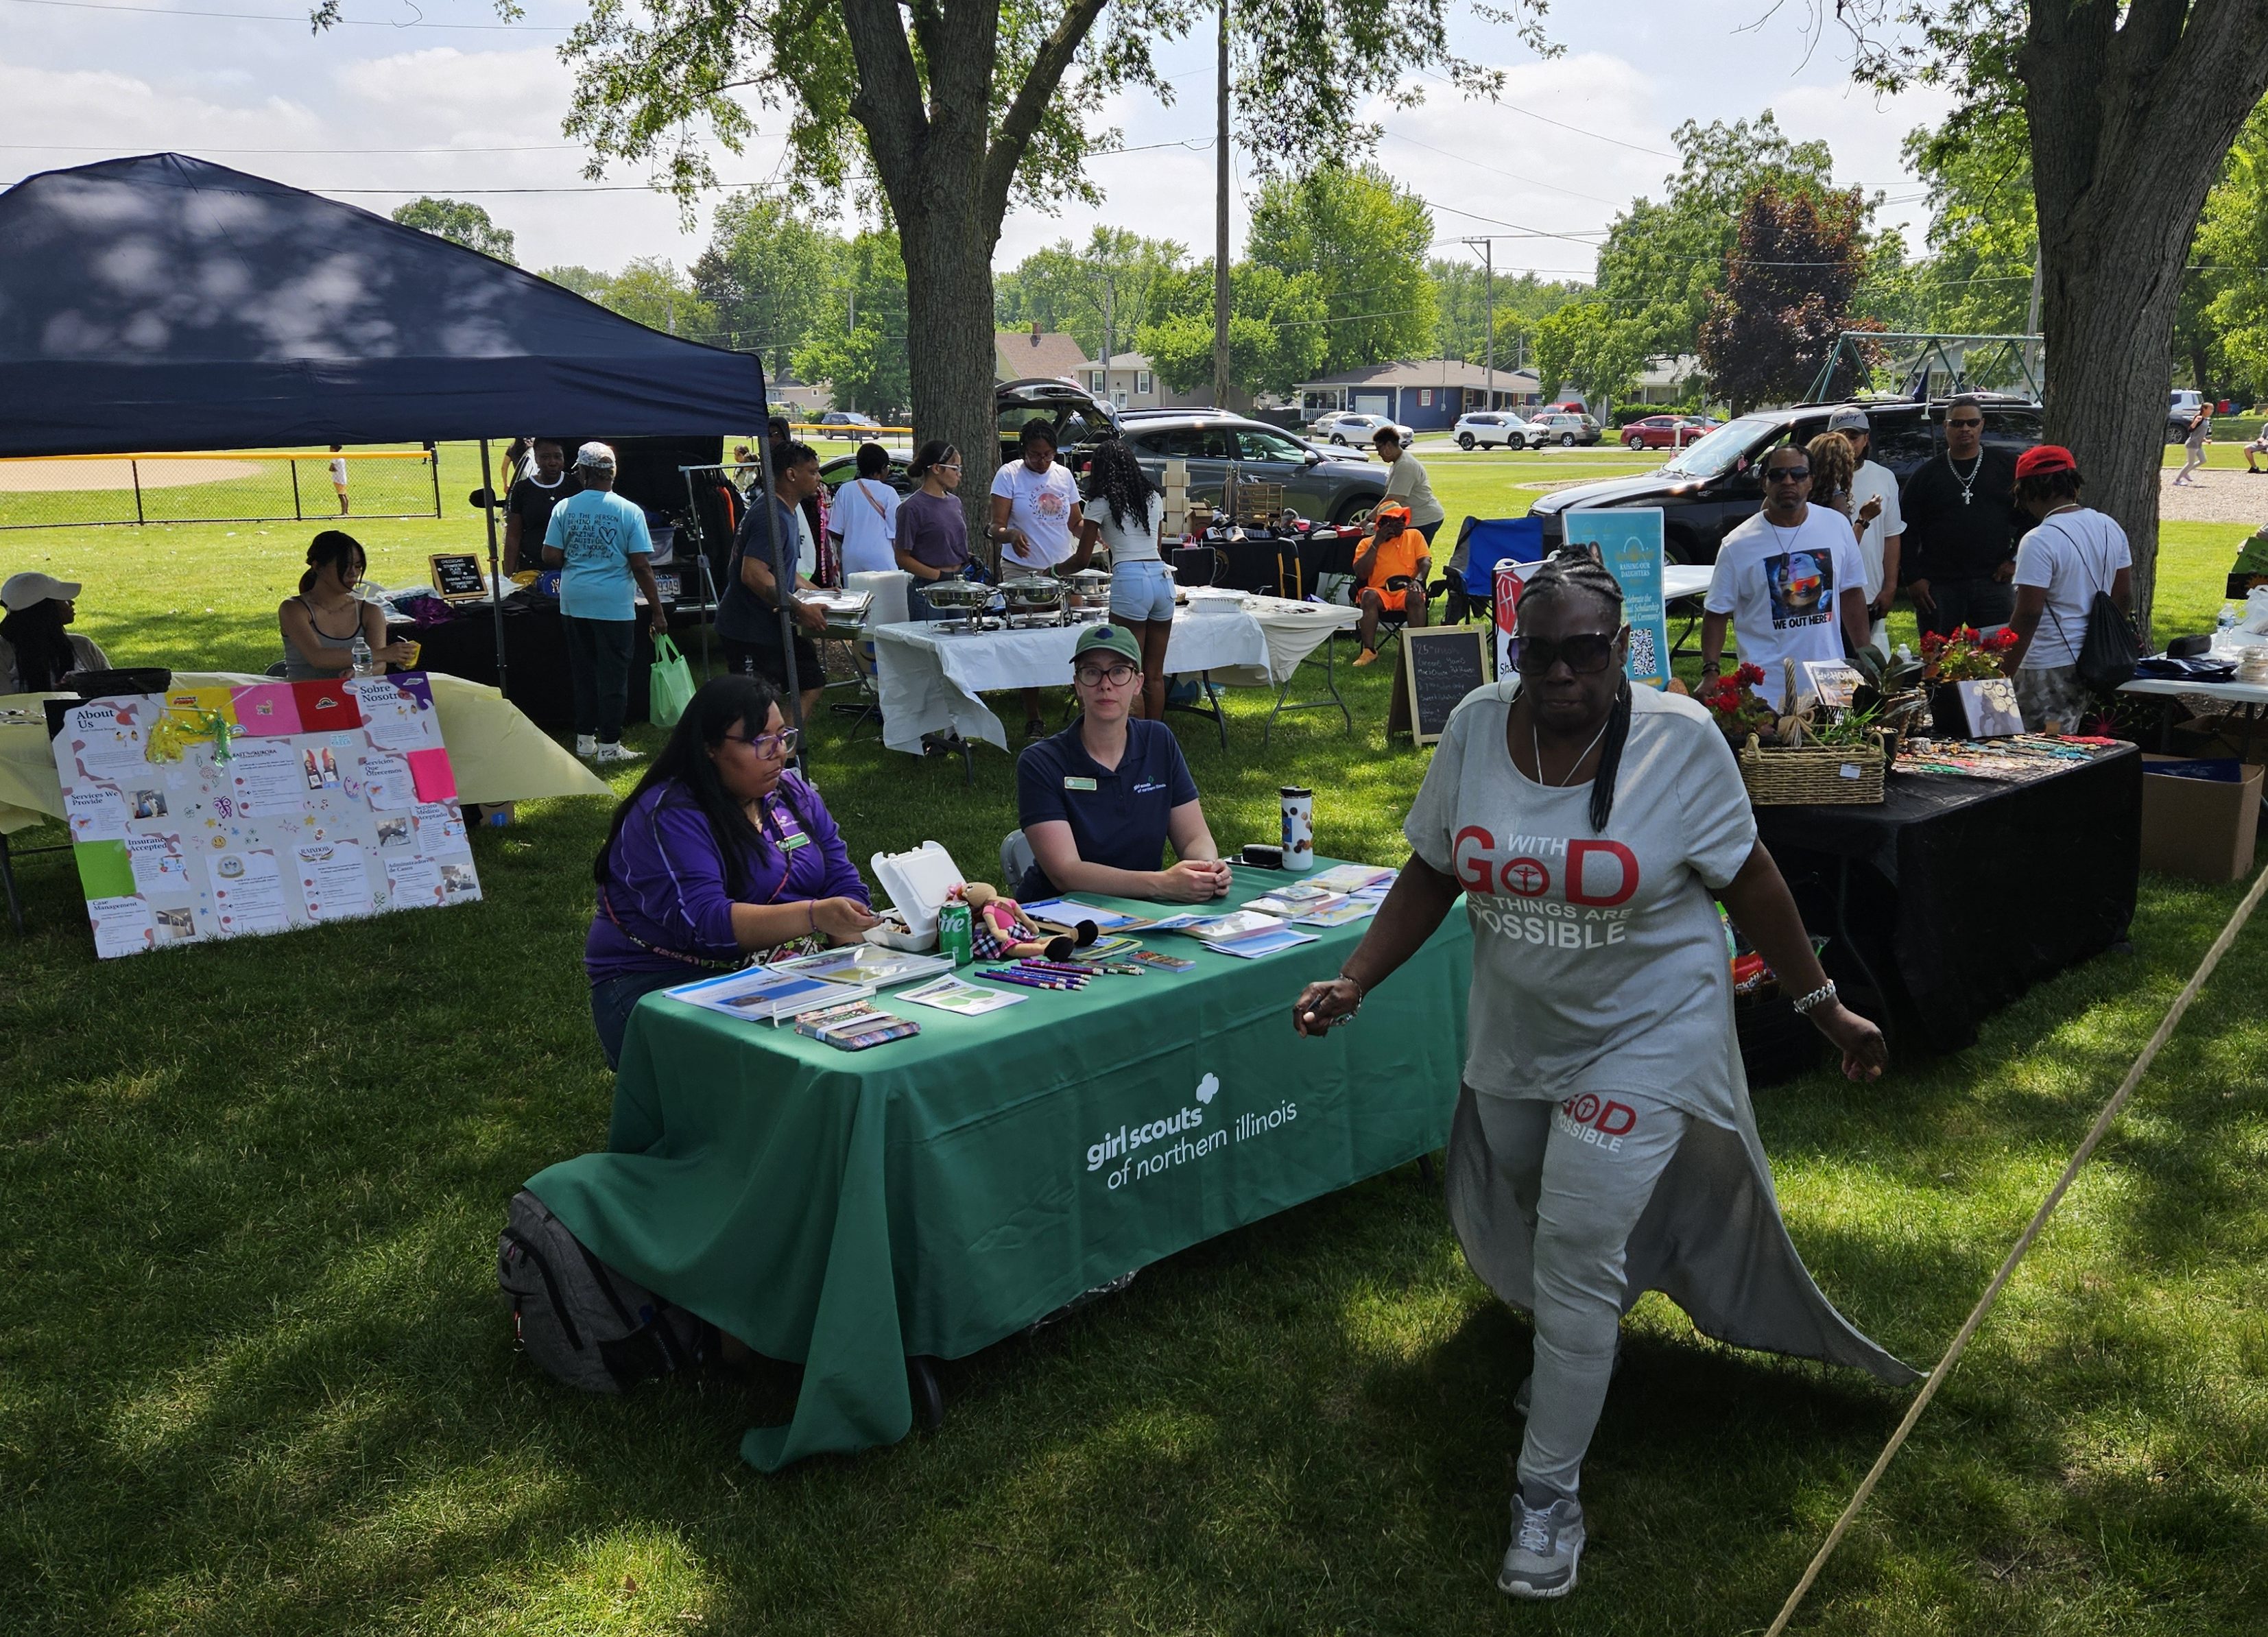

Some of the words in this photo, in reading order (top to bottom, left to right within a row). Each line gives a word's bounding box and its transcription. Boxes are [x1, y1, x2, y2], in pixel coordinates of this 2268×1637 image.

[595, 514, 618, 522] PERSON
[1773, 619, 1787, 630] WE
[1789, 617, 1807, 628] OUT
[360, 684, 390, 694] Sobre
[77, 709, 115, 719] About
[78, 720, 94, 728] Us
[364, 758, 394, 766] Servicios
[418, 813, 448, 821] Aceptado
[128, 837, 168, 846] Insurance
[1509, 833, 1568, 857] WITH
[130, 844, 167, 852] Accepted
[94, 902, 137, 911] Management
[1492, 896, 1577, 920] THINGS
[1584, 907, 1634, 921] ARE
[940, 913, 965, 933] ite
[1468, 903, 1627, 950] POSSIBLE
[1087, 1124, 1127, 1171] girl
[1130, 1106, 1203, 1149] scouts
[1107, 1157, 1132, 1190] of
[1136, 1129, 1228, 1180] northern
[1236, 1099, 1298, 1142] illinois
